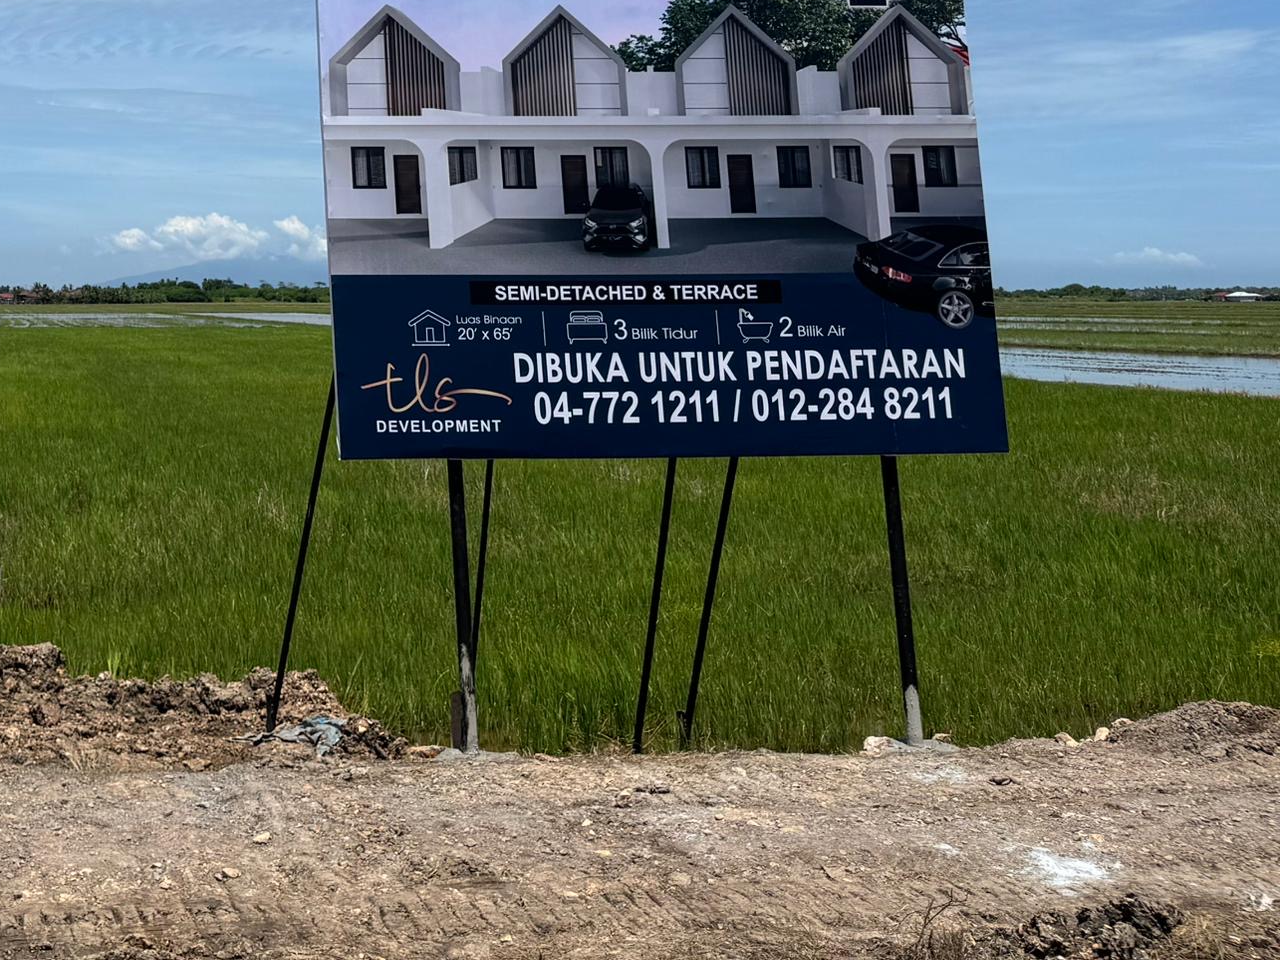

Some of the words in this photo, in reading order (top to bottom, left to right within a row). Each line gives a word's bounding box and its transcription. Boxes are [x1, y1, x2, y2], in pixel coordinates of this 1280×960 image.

[495, 285, 647, 301] SEMI-DETACHED
[652, 285, 666, 300] &
[669, 284, 758, 300] TERRACE
[455, 315, 480, 325] Luas
[483, 315, 522, 325] Binaan
[613, 318, 628, 340] 3
[631, 327, 658, 340] Bilik
[661, 327, 698, 340] Tidur
[779, 316, 794, 337] 2
[797, 325, 824, 337] Bilik
[827, 325, 846, 337] Air
[481, 331, 490, 340] x
[513, 352, 629, 384] DIBUKA
[639, 350, 737, 382] UNTUK
[746, 348, 966, 381] PENDAFTARAN
[534, 390, 640, 425] 04-772
[651, 388, 720, 424] 1211
[733, 388, 741, 423] /
[751, 387, 875, 422] 012-284
[884, 386, 953, 420] 8211
[376, 419, 502, 433] DEVELOPMENT
